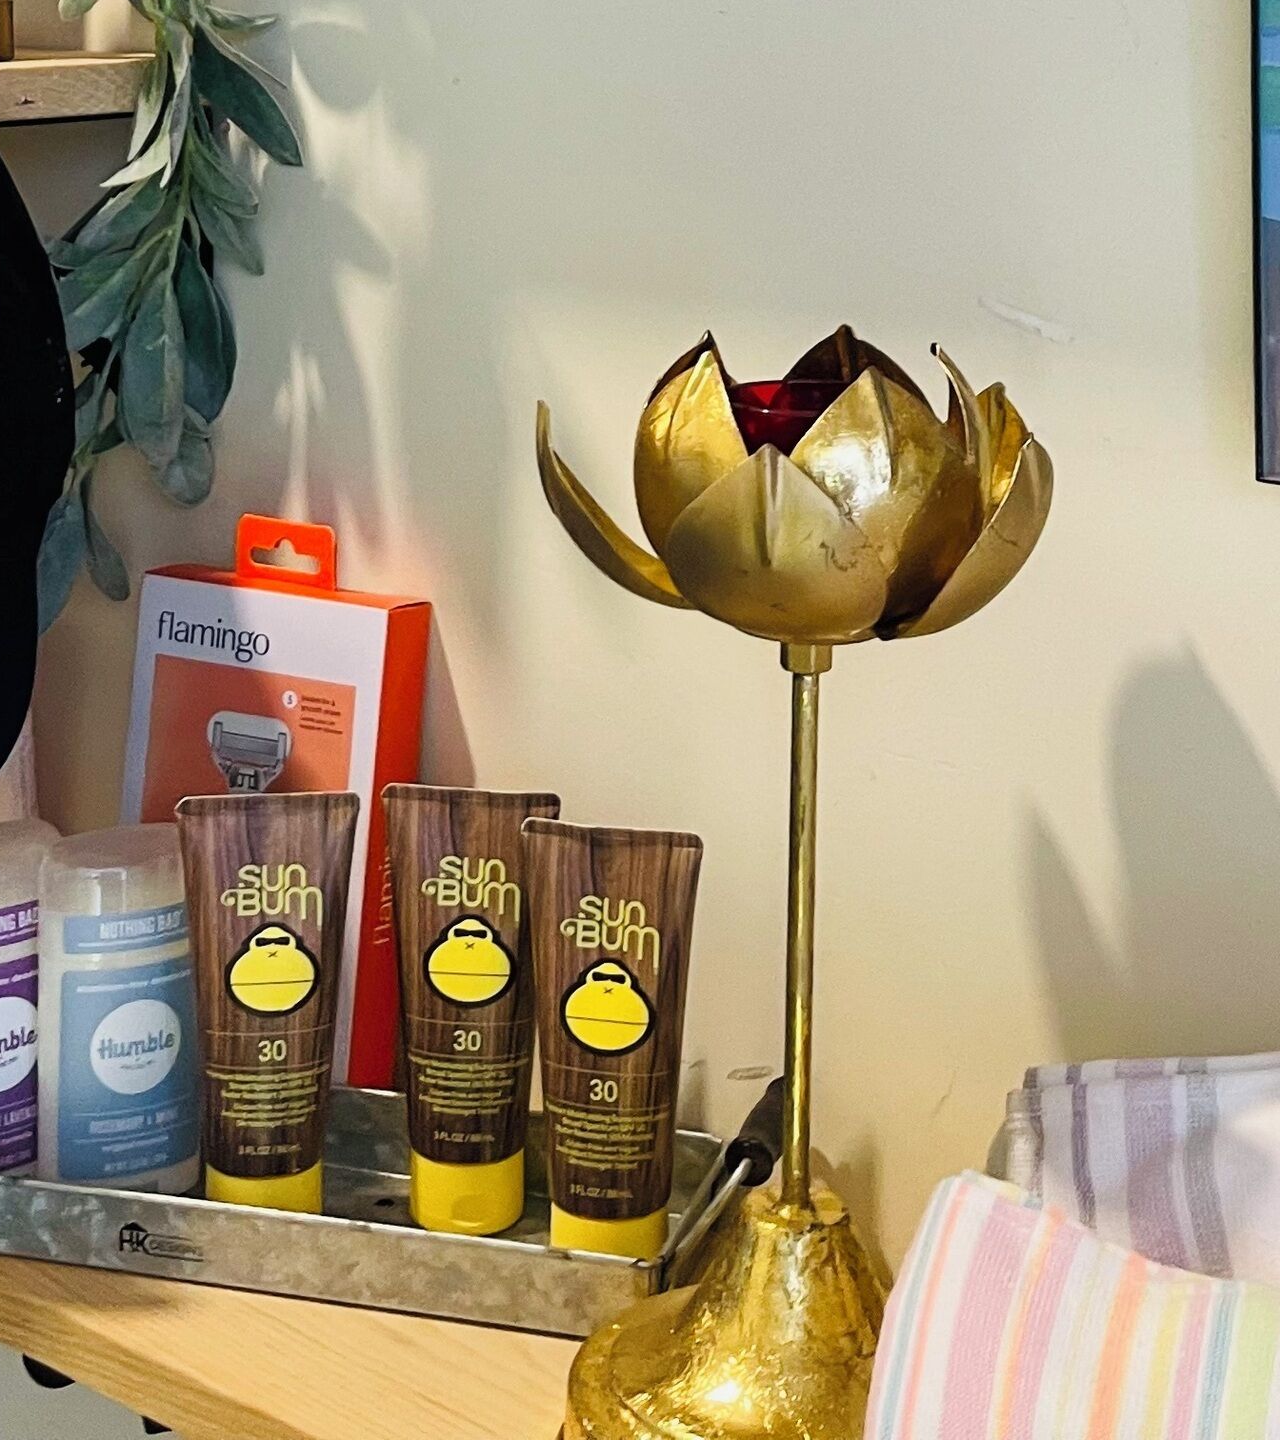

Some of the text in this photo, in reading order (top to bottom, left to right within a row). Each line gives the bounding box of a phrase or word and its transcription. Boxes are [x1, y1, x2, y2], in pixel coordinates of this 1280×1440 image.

[158, 611, 270, 662] flamingo
[100, 917, 155, 939] NOTHING
[97, 1029, 175, 1059] Humble
[258, 1040, 287, 1062] 30
[453, 1030, 481, 1051] 30
[589, 1079, 618, 1103] 30
